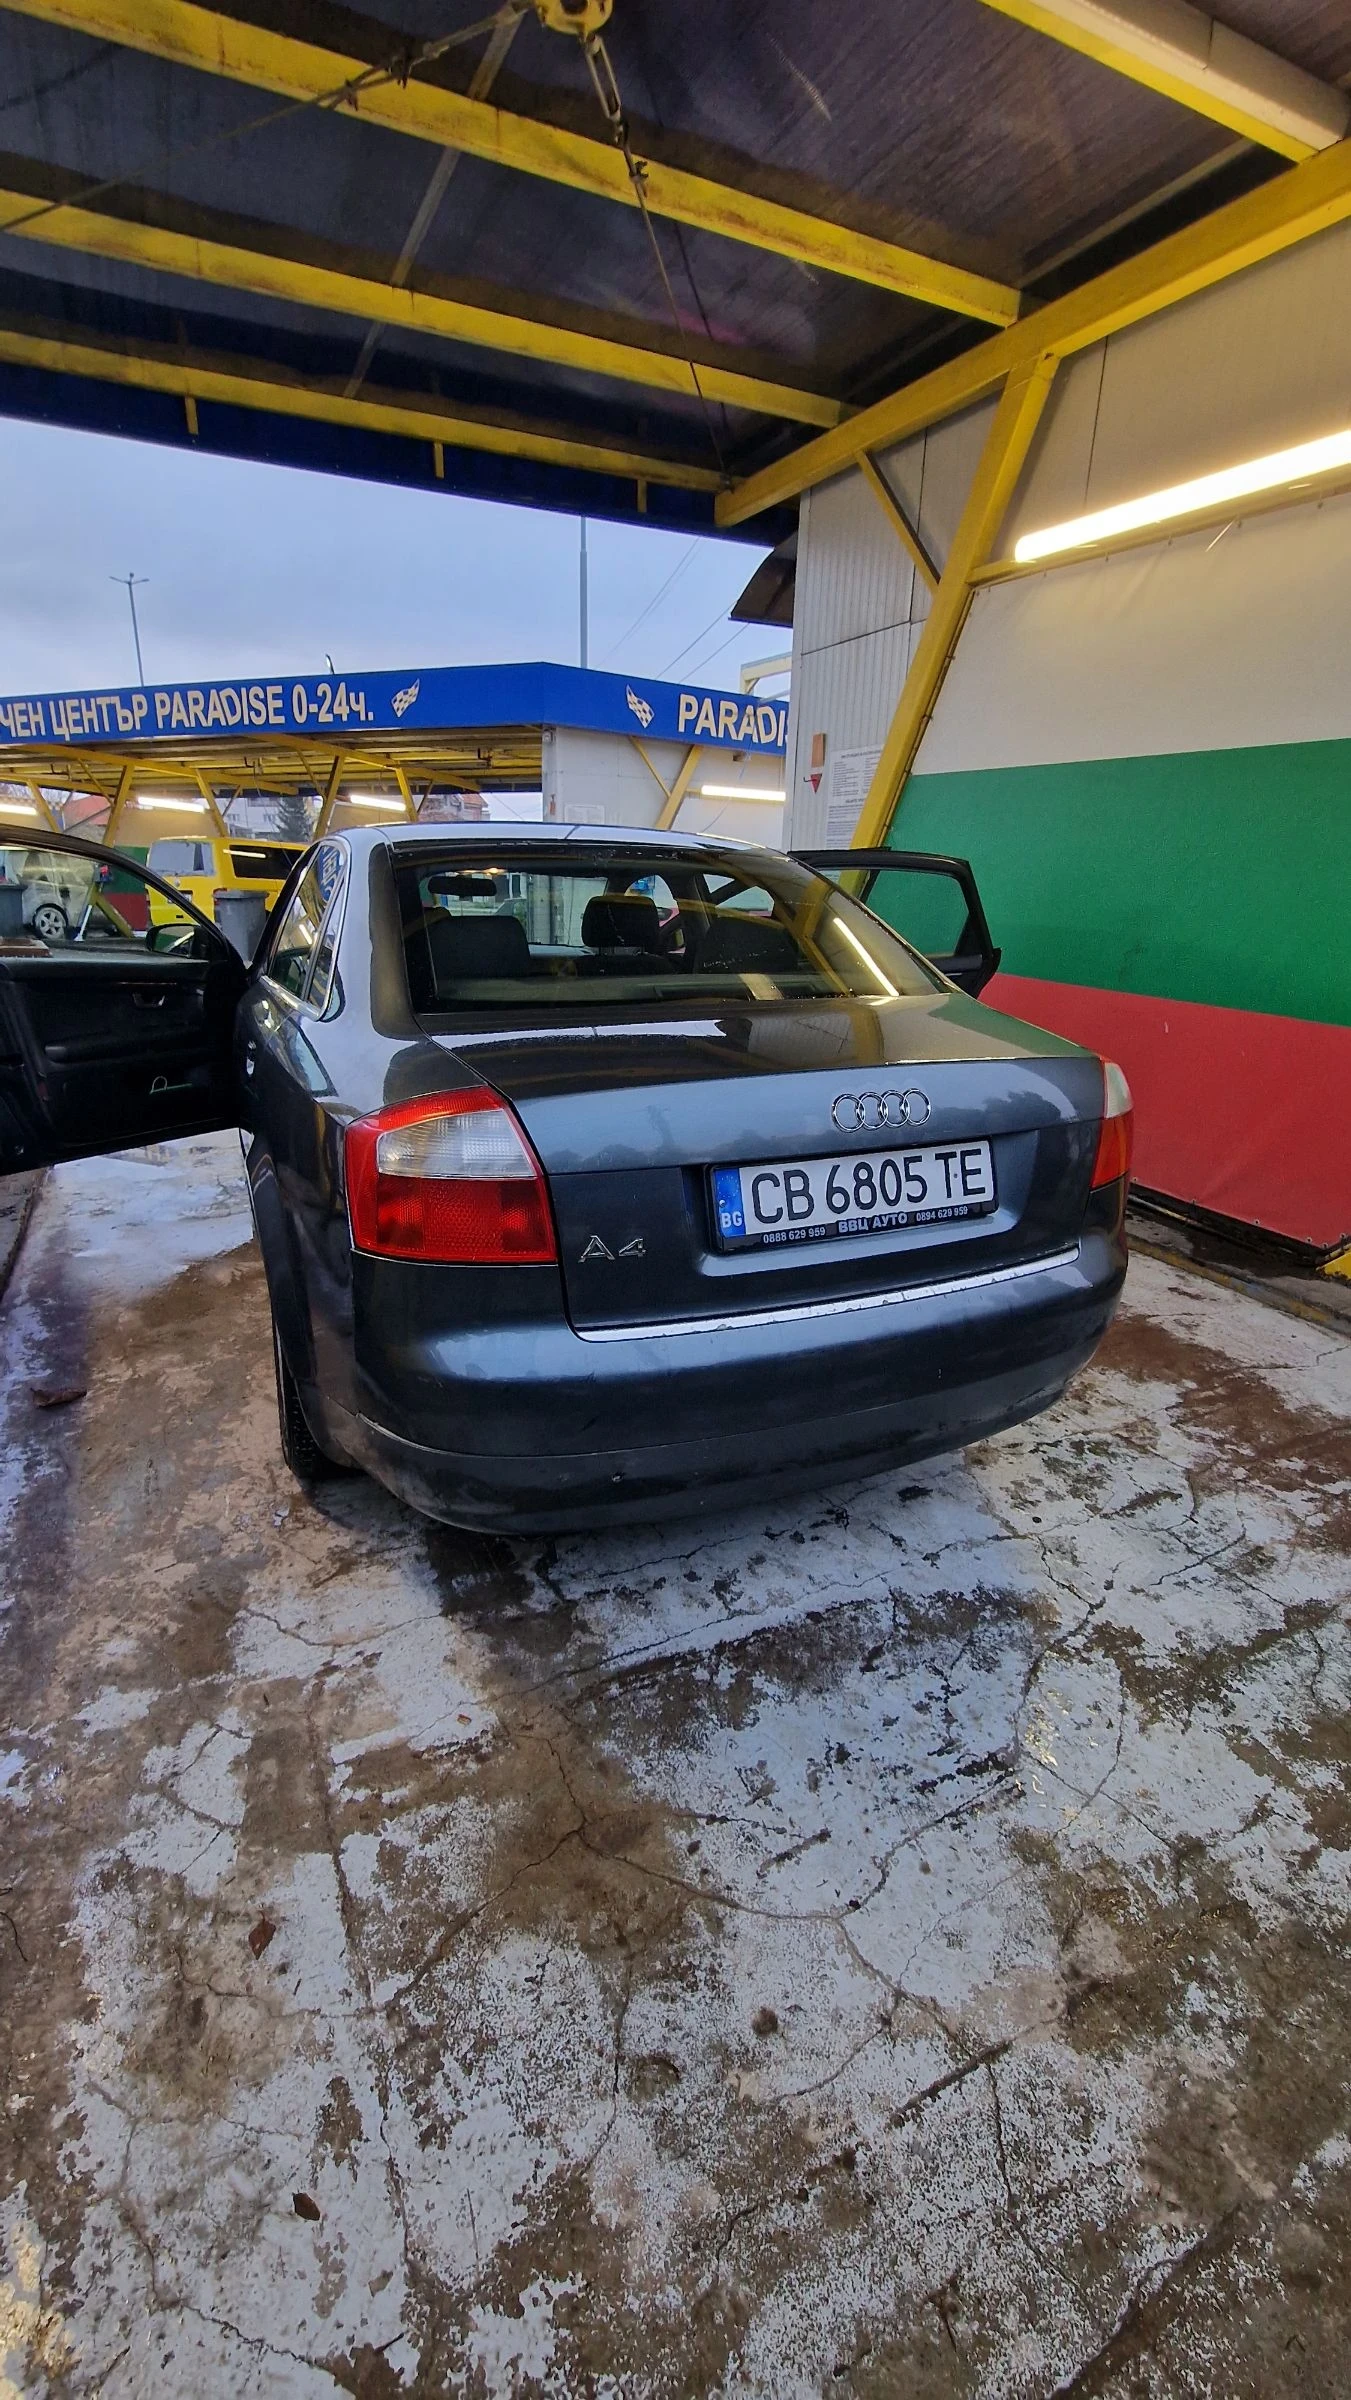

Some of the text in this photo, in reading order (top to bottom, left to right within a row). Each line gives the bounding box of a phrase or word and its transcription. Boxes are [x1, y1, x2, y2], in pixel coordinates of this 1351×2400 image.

[49, 694, 148, 741] ЦЕНТЪР
[155, 685, 285, 728] PARADISE
[292, 682, 374, 724] 0-24ч.
[678, 694, 789, 747] PARADI
[826, 1156, 928, 1214] 6805
[935, 1148, 986, 1199] TE
[720, 1211, 743, 1229] BG
[763, 1232, 787, 1243] 0888
[789, 1229, 807, 1240] 629
[808, 1226, 826, 1237] 959
[872, 1212, 908, 1229] АУТО
[937, 1207, 953, 1218] 629
[953, 1205, 969, 1216] 959
[578, 1234, 647, 1263] A4
